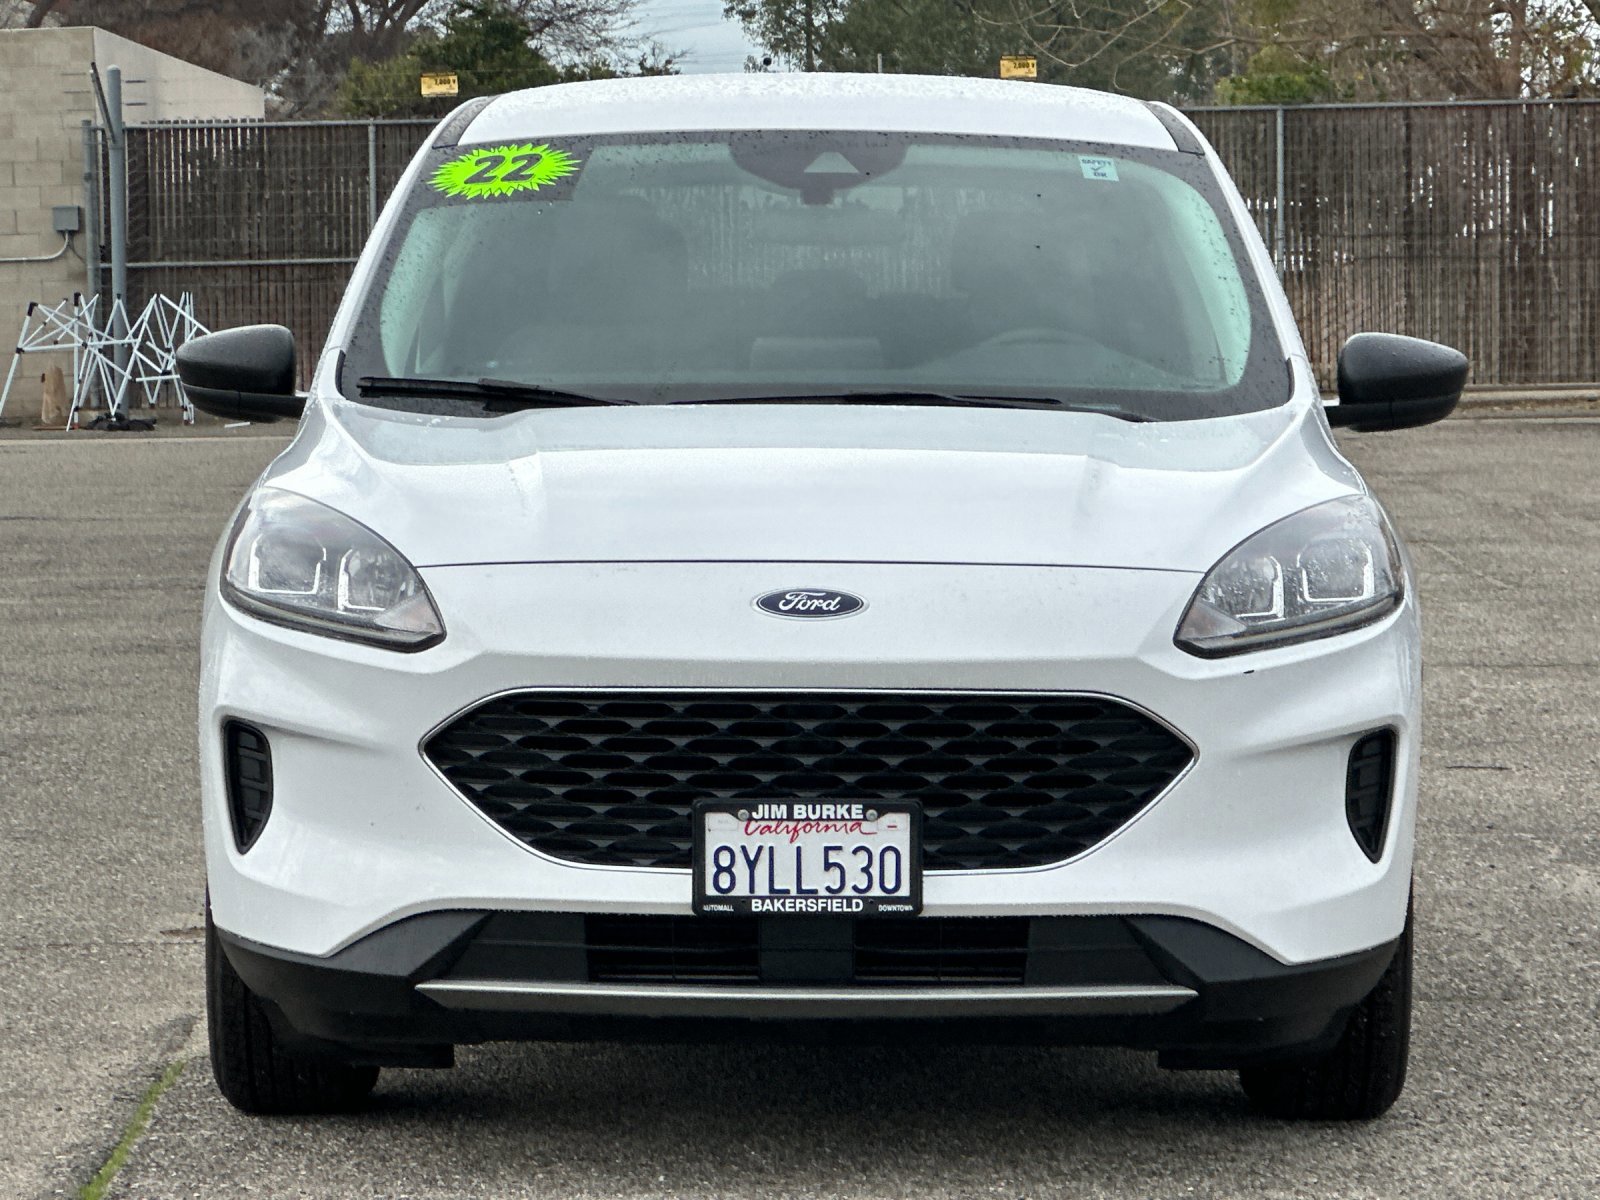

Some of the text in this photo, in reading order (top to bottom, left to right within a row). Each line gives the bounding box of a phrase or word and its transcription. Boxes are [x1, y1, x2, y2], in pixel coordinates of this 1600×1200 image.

[464, 153, 543, 184] 22
[779, 591, 841, 611] Ford
[752, 804, 864, 820] JIM BURKE
[744, 819, 877, 843] California
[712, 845, 902, 895] 8YLL530
[702, 904, 735, 912] AUTOMALL
[751, 899, 864, 912] BAKERSFIELD
[878, 904, 914, 912] DOWNTOWN
